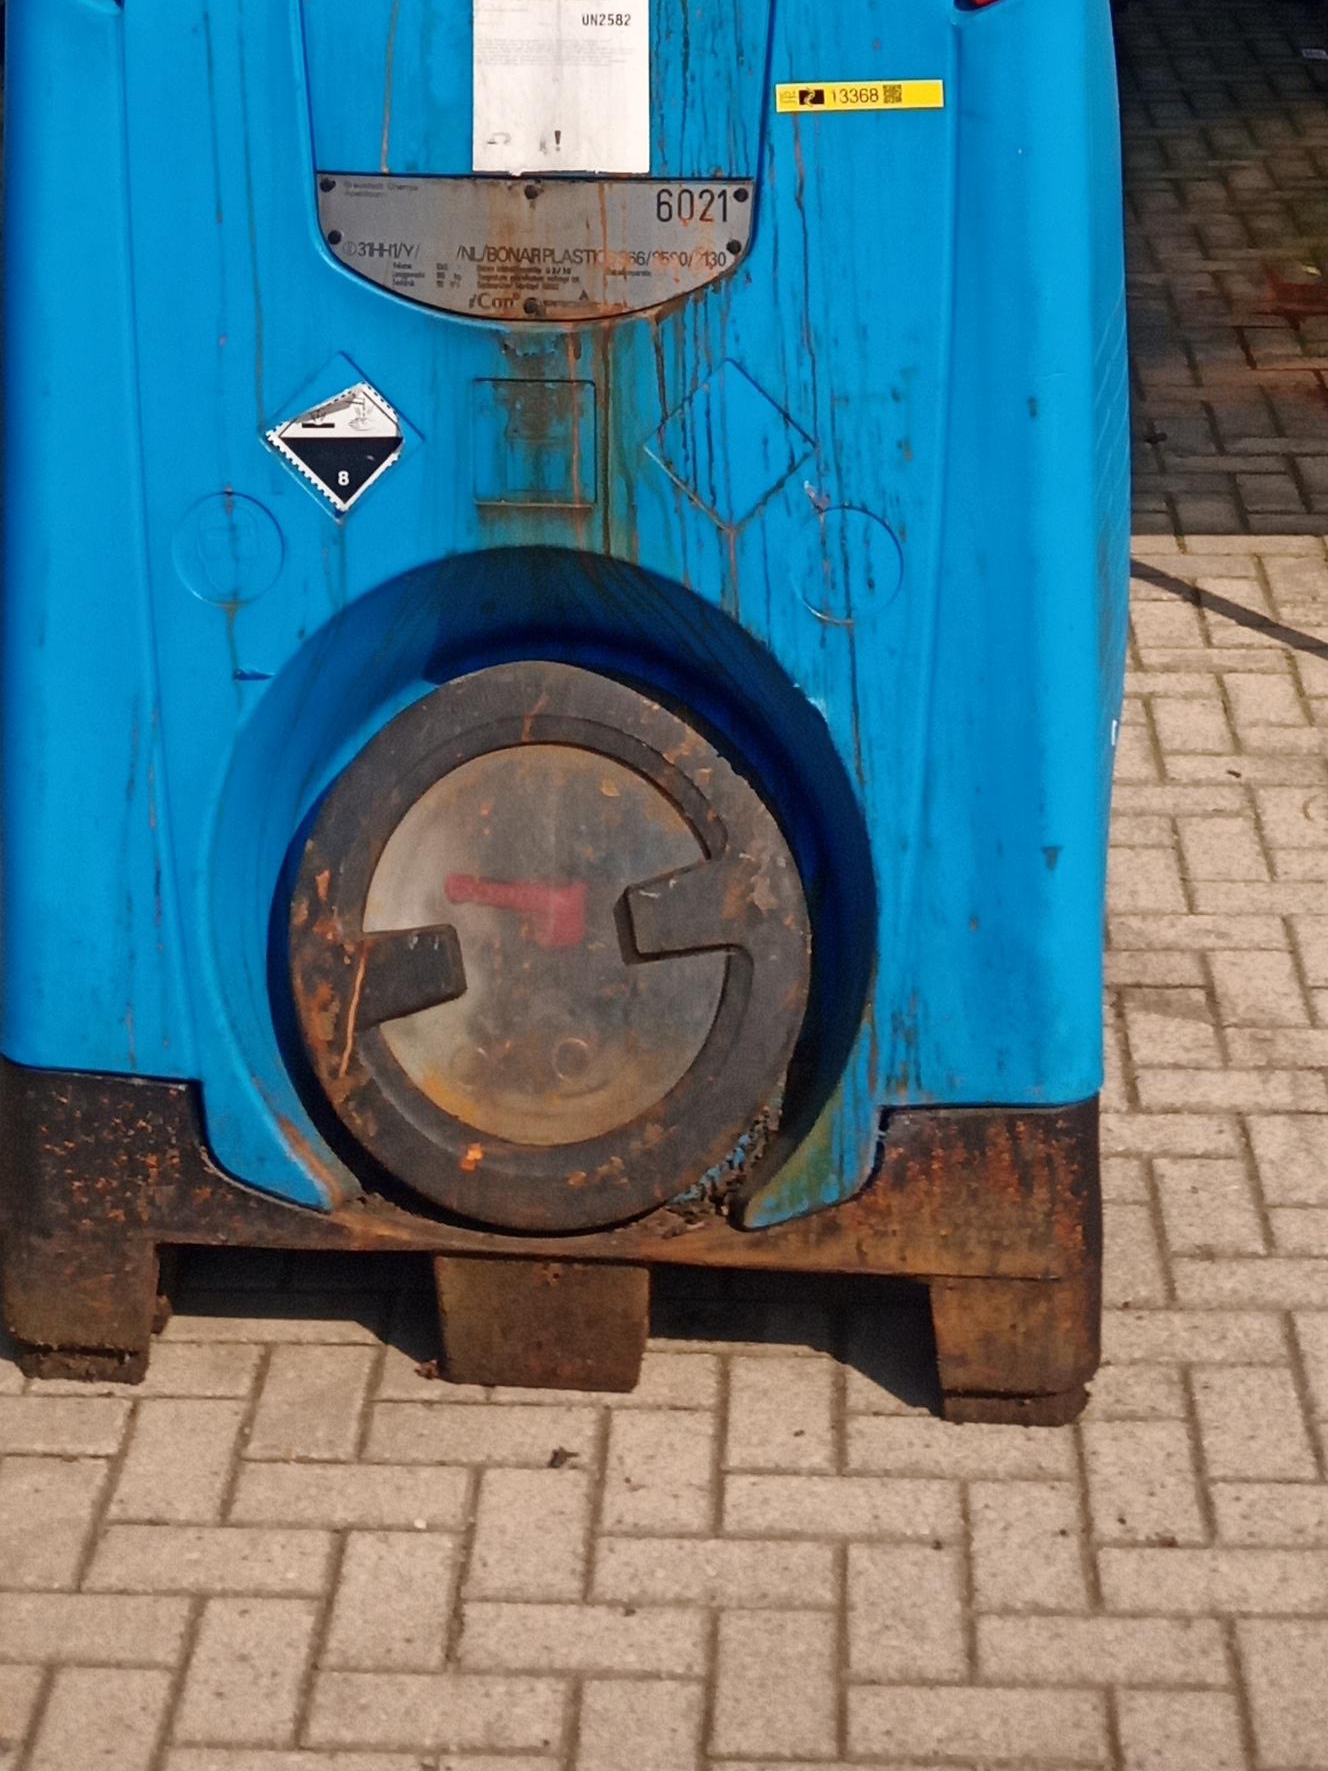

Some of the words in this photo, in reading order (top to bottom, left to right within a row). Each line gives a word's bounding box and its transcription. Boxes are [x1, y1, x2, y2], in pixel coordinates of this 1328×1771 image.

[581, 13, 632, 26] UN2582
[831, 88, 879, 104] 13368
[656, 188, 727, 222] 6021
[337, 470, 350, 486] 8
